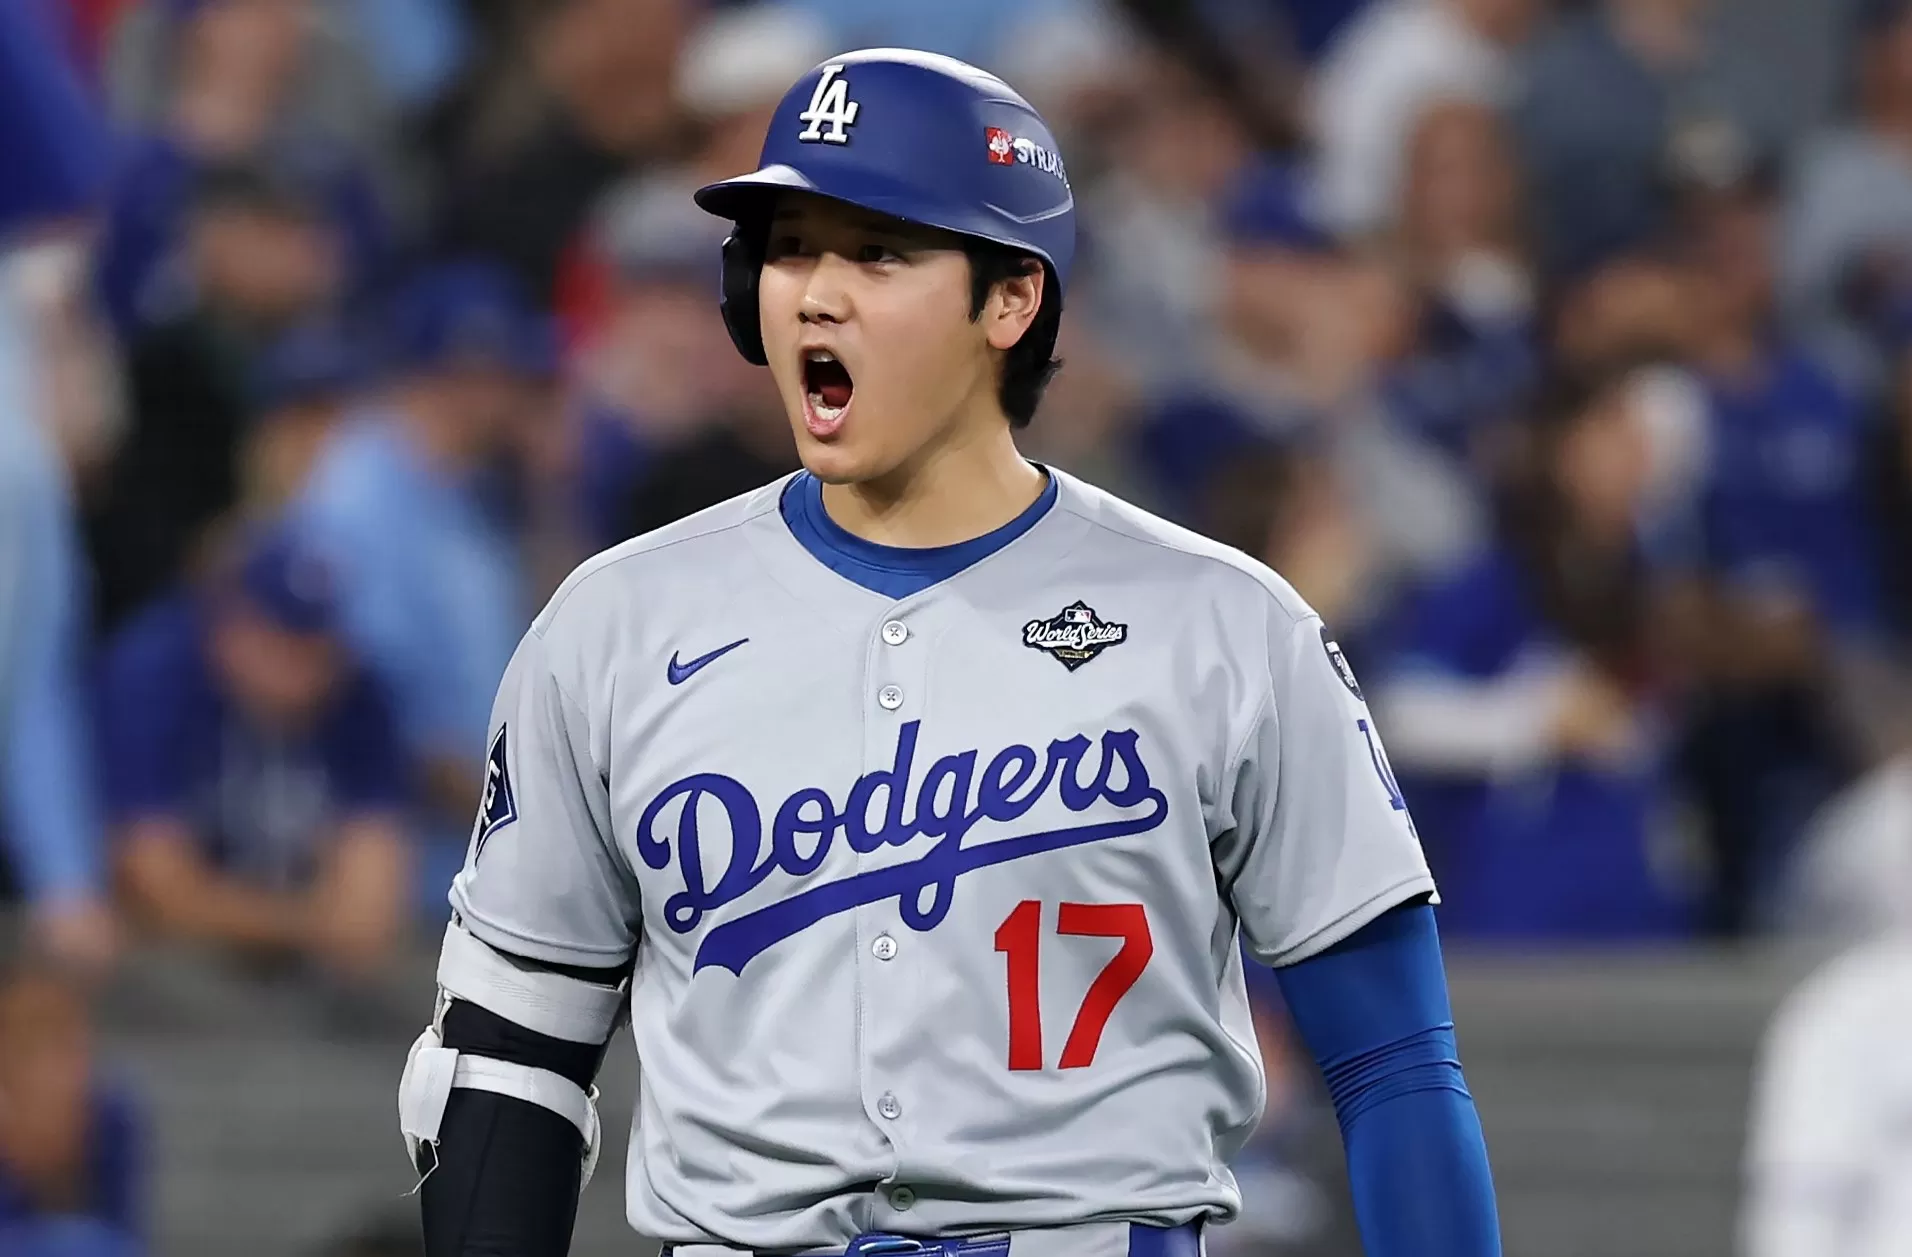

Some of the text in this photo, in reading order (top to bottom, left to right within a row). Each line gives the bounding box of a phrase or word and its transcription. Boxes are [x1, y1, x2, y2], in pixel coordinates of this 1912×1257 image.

[799, 65, 859, 145] LA
[1026, 622, 1123, 650] World Series
[637, 720, 1163, 935] Dodgers
[994, 900, 1153, 1071] 17
